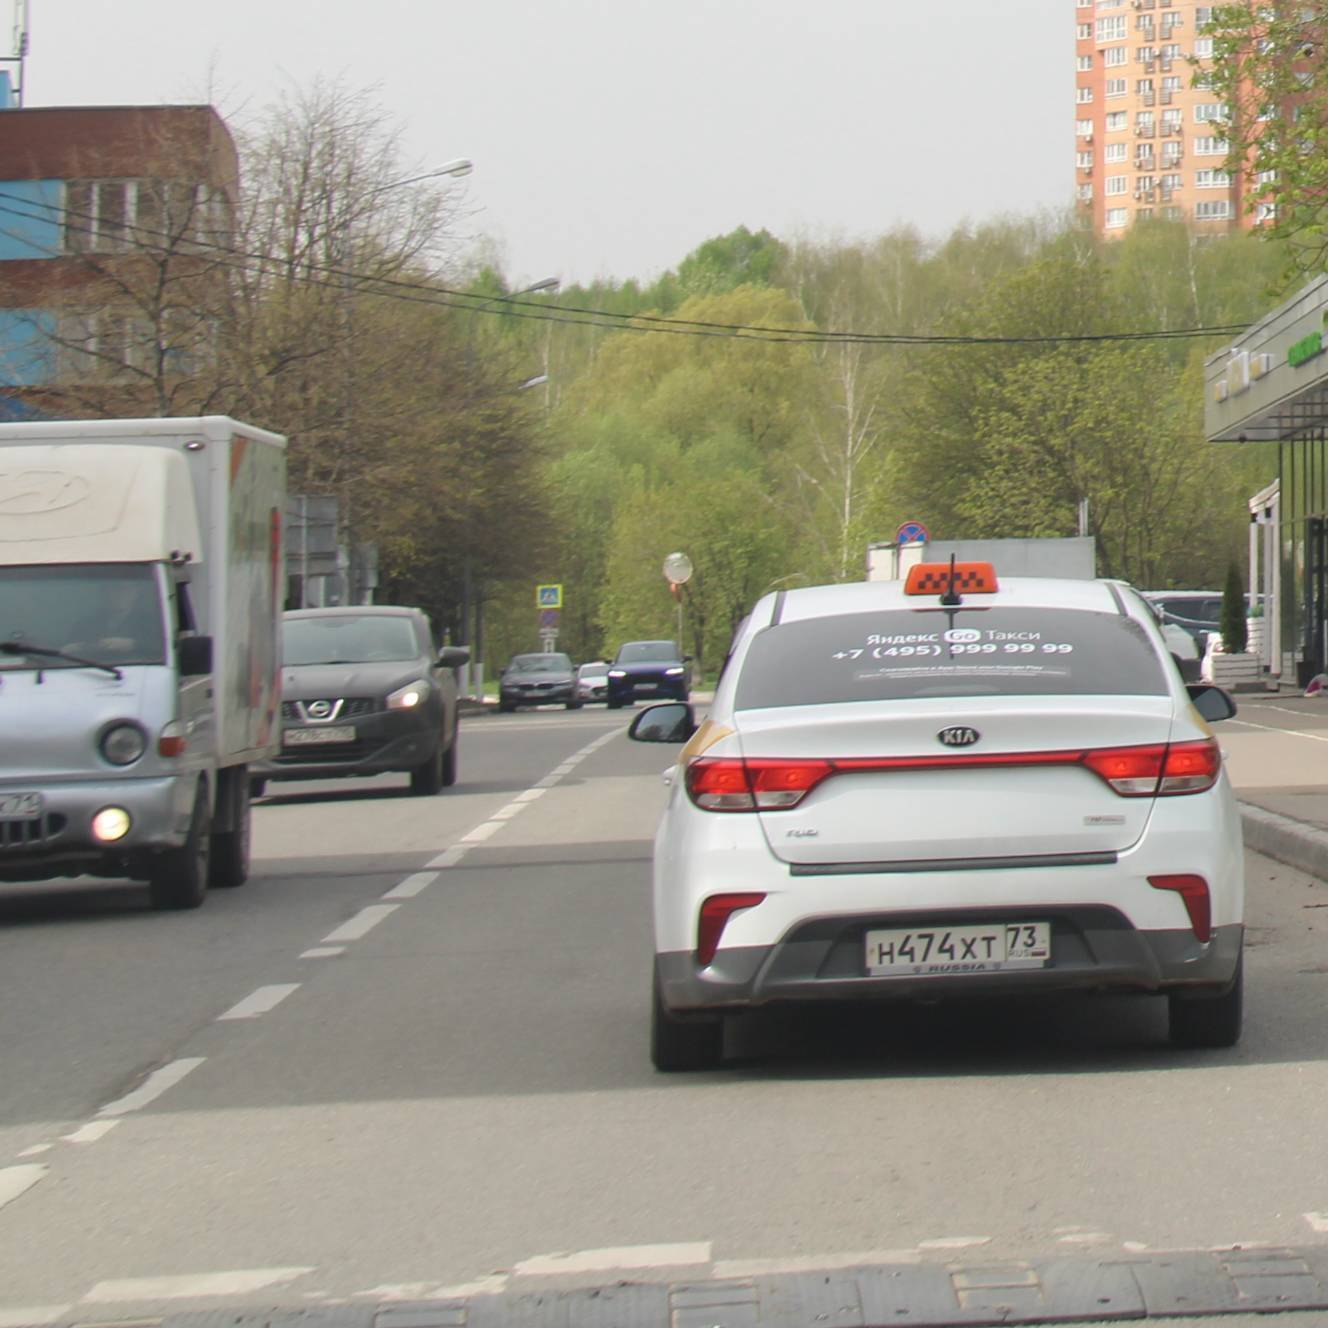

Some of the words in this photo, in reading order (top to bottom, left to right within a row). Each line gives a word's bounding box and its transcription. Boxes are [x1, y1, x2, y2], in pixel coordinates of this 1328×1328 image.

[866, 632, 939, 646] Яндекс
[985, 629, 1041, 641] Такси
[831, 649, 865, 660] +7
[871, 645, 943, 659] (495)
[949, 643, 997, 655] 999
[1004, 643, 1036, 654] 99
[1041, 643, 1073, 654] 99
[942, 728, 976, 743] KIA
[1006, 925, 1037, 949] 73
